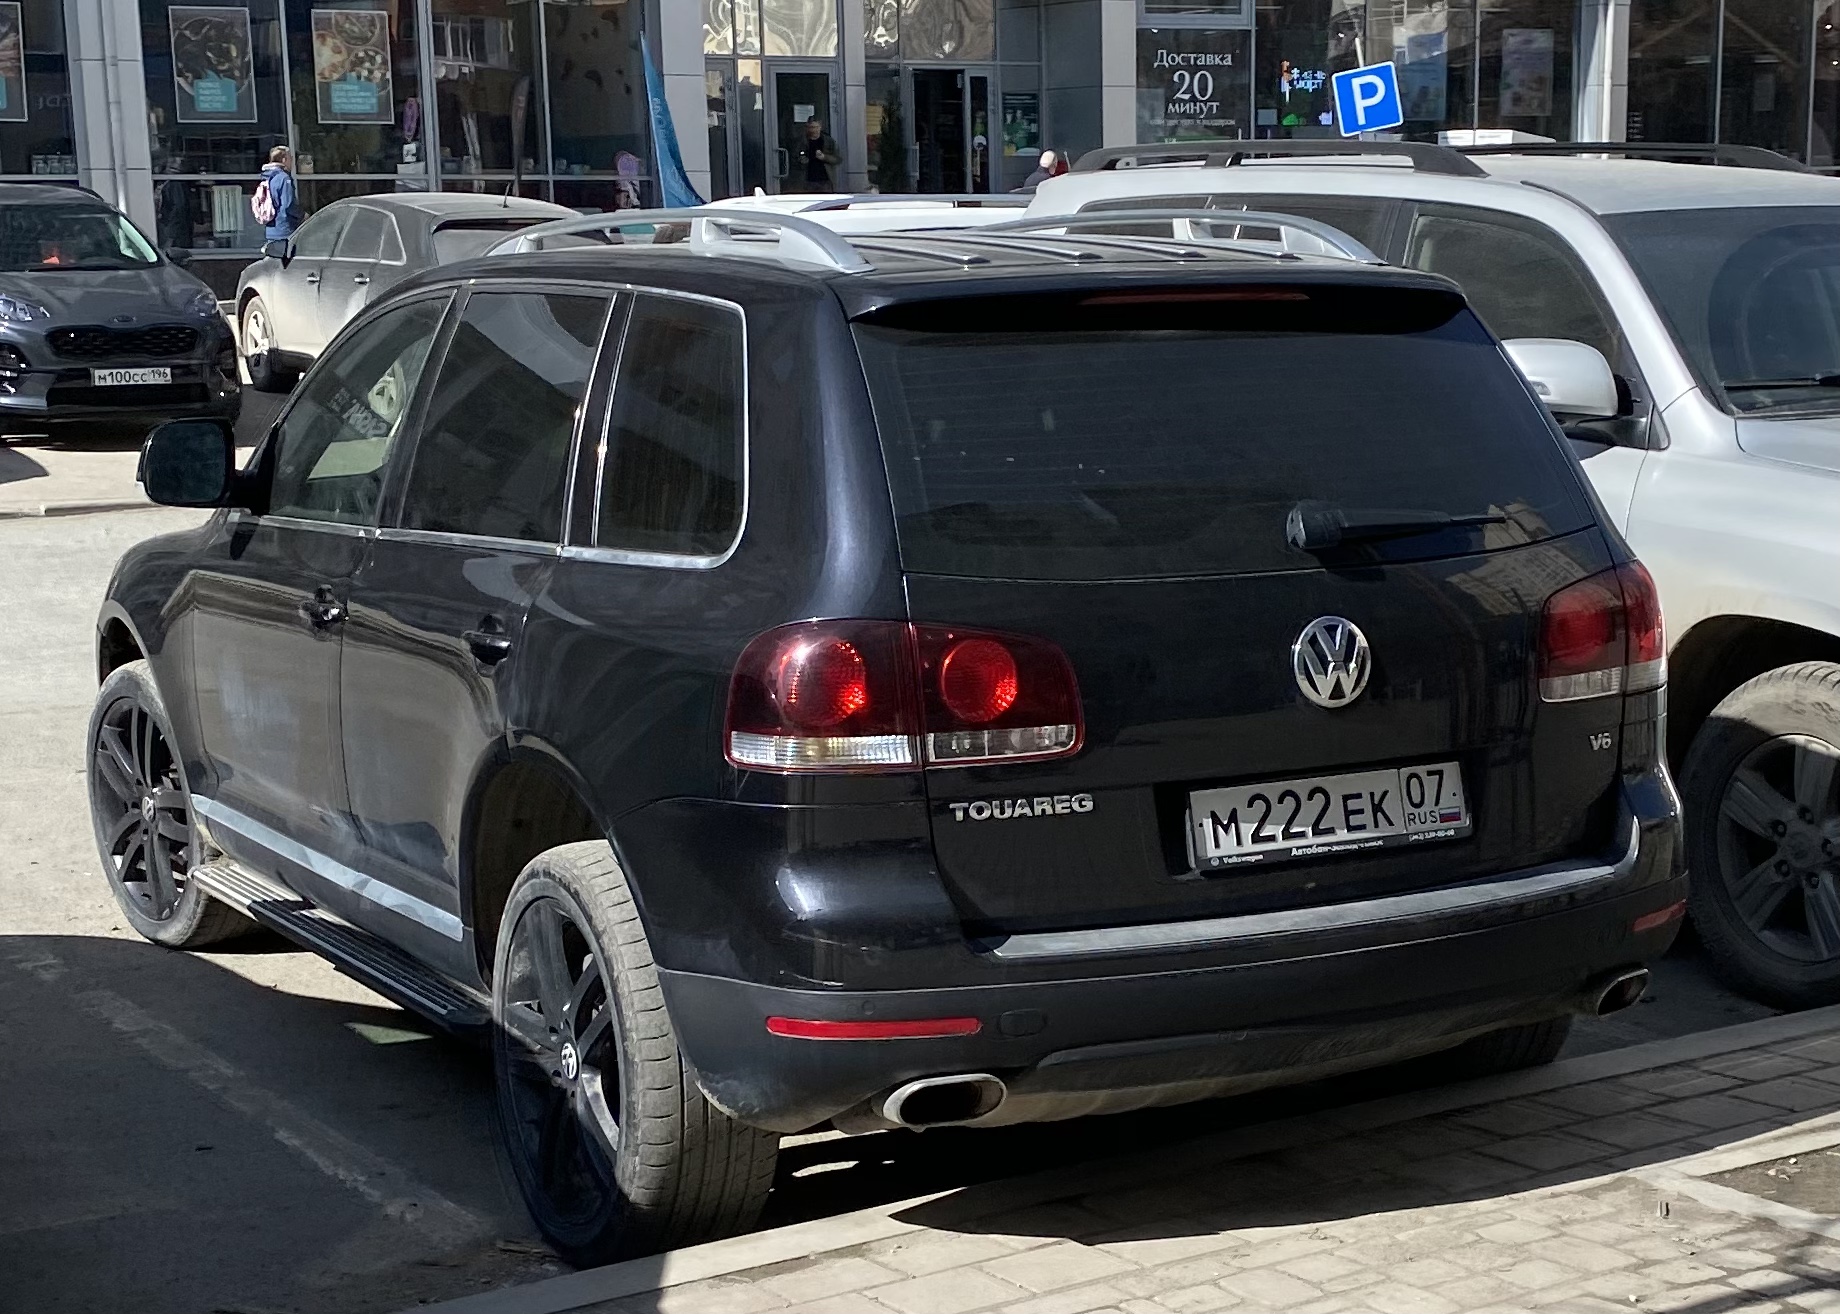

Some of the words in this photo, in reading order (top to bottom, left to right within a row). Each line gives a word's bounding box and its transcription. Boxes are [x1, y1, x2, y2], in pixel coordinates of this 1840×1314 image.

[1152, 49, 1232, 68] Доставка
[1172, 70, 1214, 101] 20
[1167, 102, 1220, 118] минут
[1351, 74, 1386, 126] P
[1589, 732, 1612, 751] V6
[1405, 769, 1445, 809] 07
[949, 793, 1094, 821] TOUAREG
[1407, 810, 1438, 826] RUS
